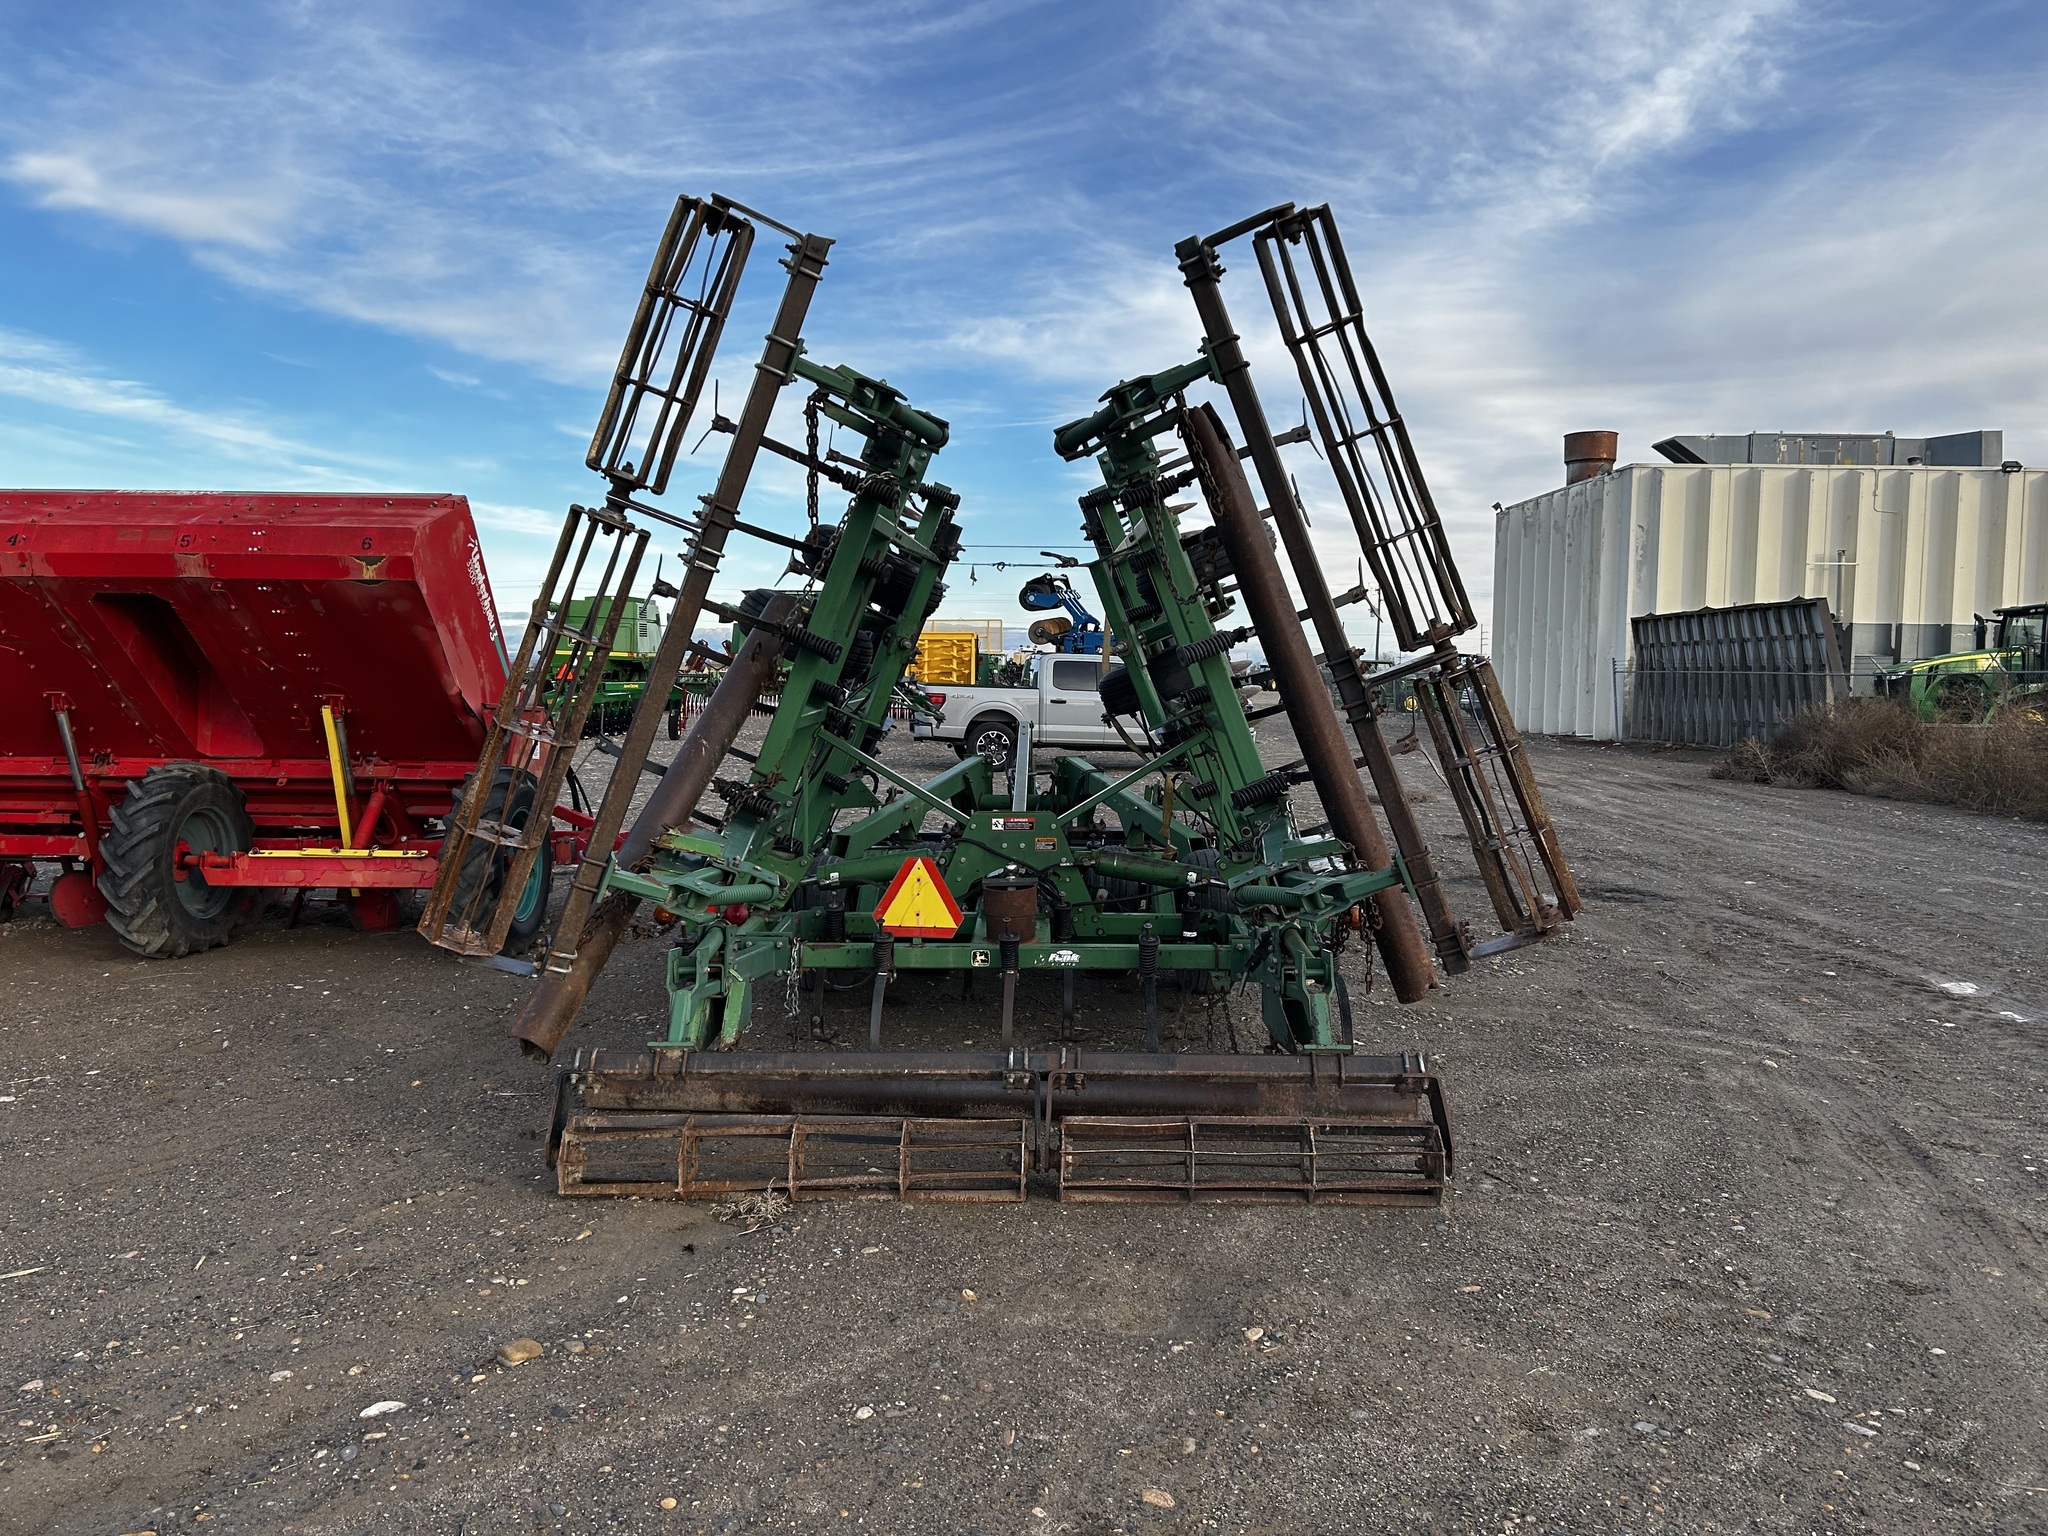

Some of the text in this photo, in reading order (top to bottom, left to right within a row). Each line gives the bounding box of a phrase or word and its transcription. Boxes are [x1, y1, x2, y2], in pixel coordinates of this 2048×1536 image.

[6, 533, 19, 547] 4
[180, 534, 191, 548] 5
[361, 537, 373, 550] 6
